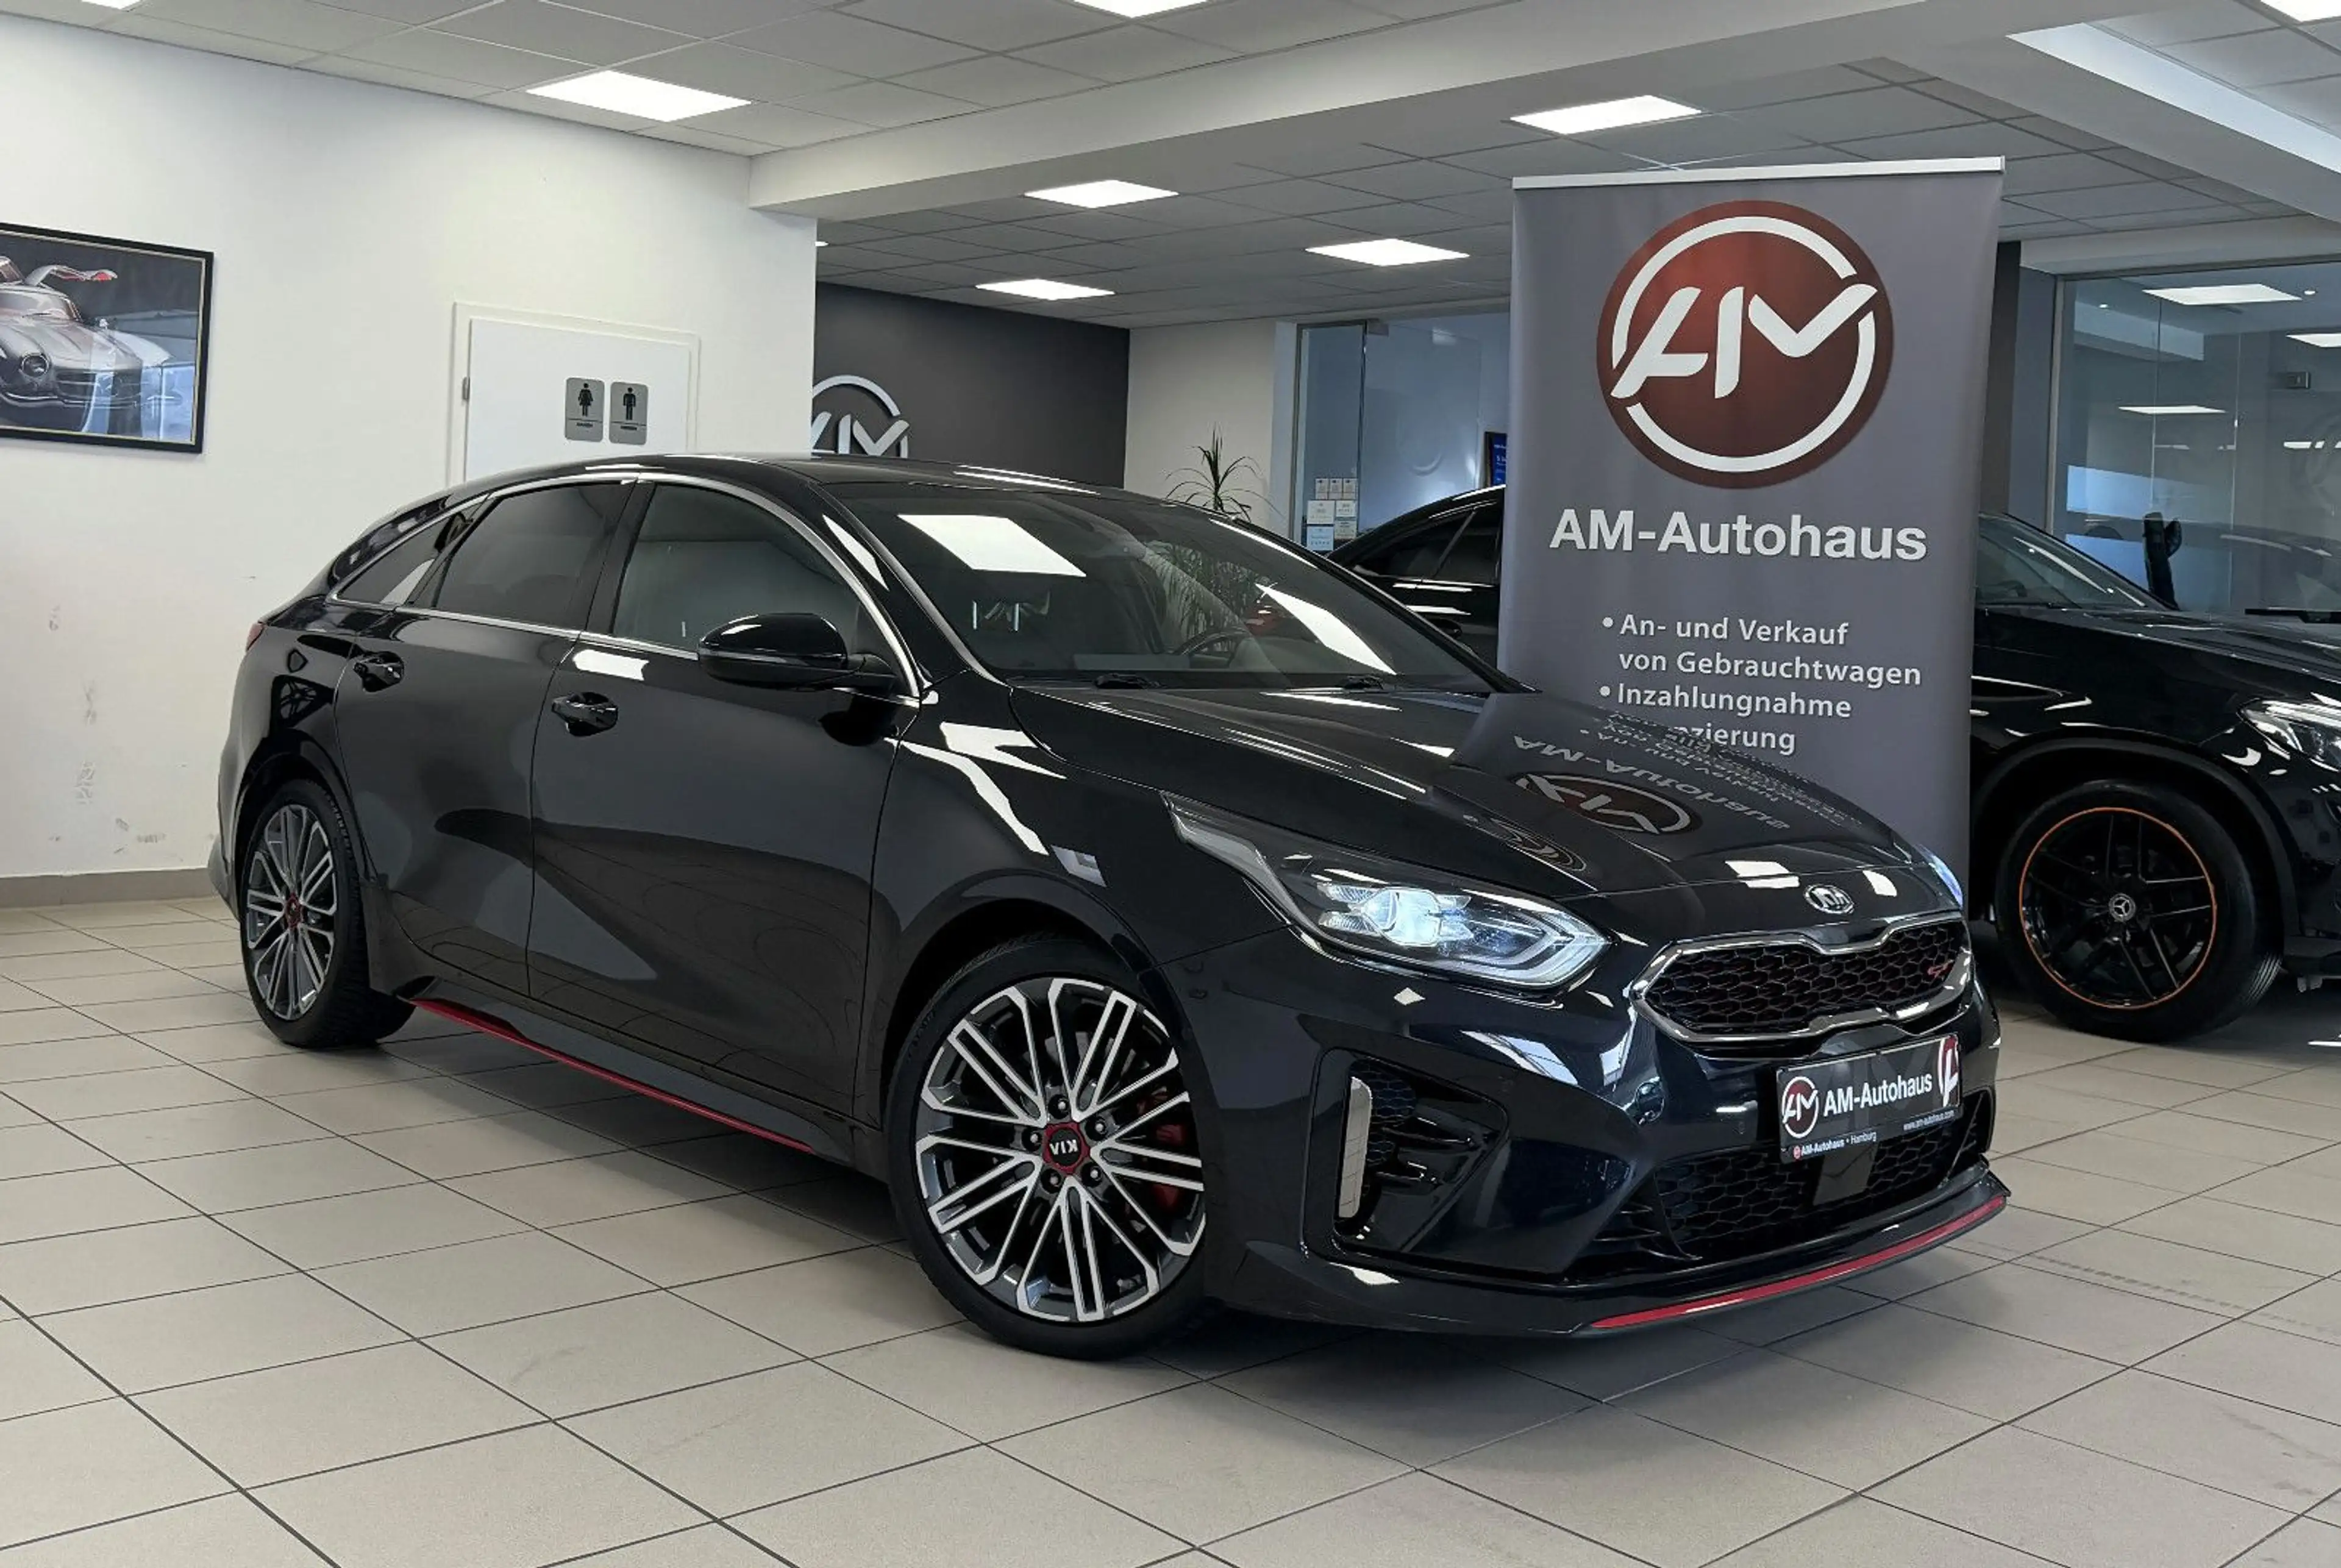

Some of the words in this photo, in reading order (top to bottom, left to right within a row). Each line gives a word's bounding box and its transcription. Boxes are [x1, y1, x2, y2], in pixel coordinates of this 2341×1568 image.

[1610, 283, 1878, 399] AM
[1549, 508, 1927, 561] AM-Autohaus
[1619, 614, 1667, 636] An-
[1676, 617, 1729, 640] und
[1738, 618, 1850, 645] Verkauf
[1619, 654, 1667, 671] von
[1676, 651, 1922, 690] Gebrauchtwagen
[1618, 683, 1853, 718] Inzahlungnahme
[1675, 723, 1796, 756] zierung
[1823, 1073, 1933, 1117] AM-Autohaus
[1049, 1139, 1078, 1155] KIA
[1801, 1138, 1845, 1156] AM-Autohaus
[1850, 1130, 1877, 1146] Hamburg
